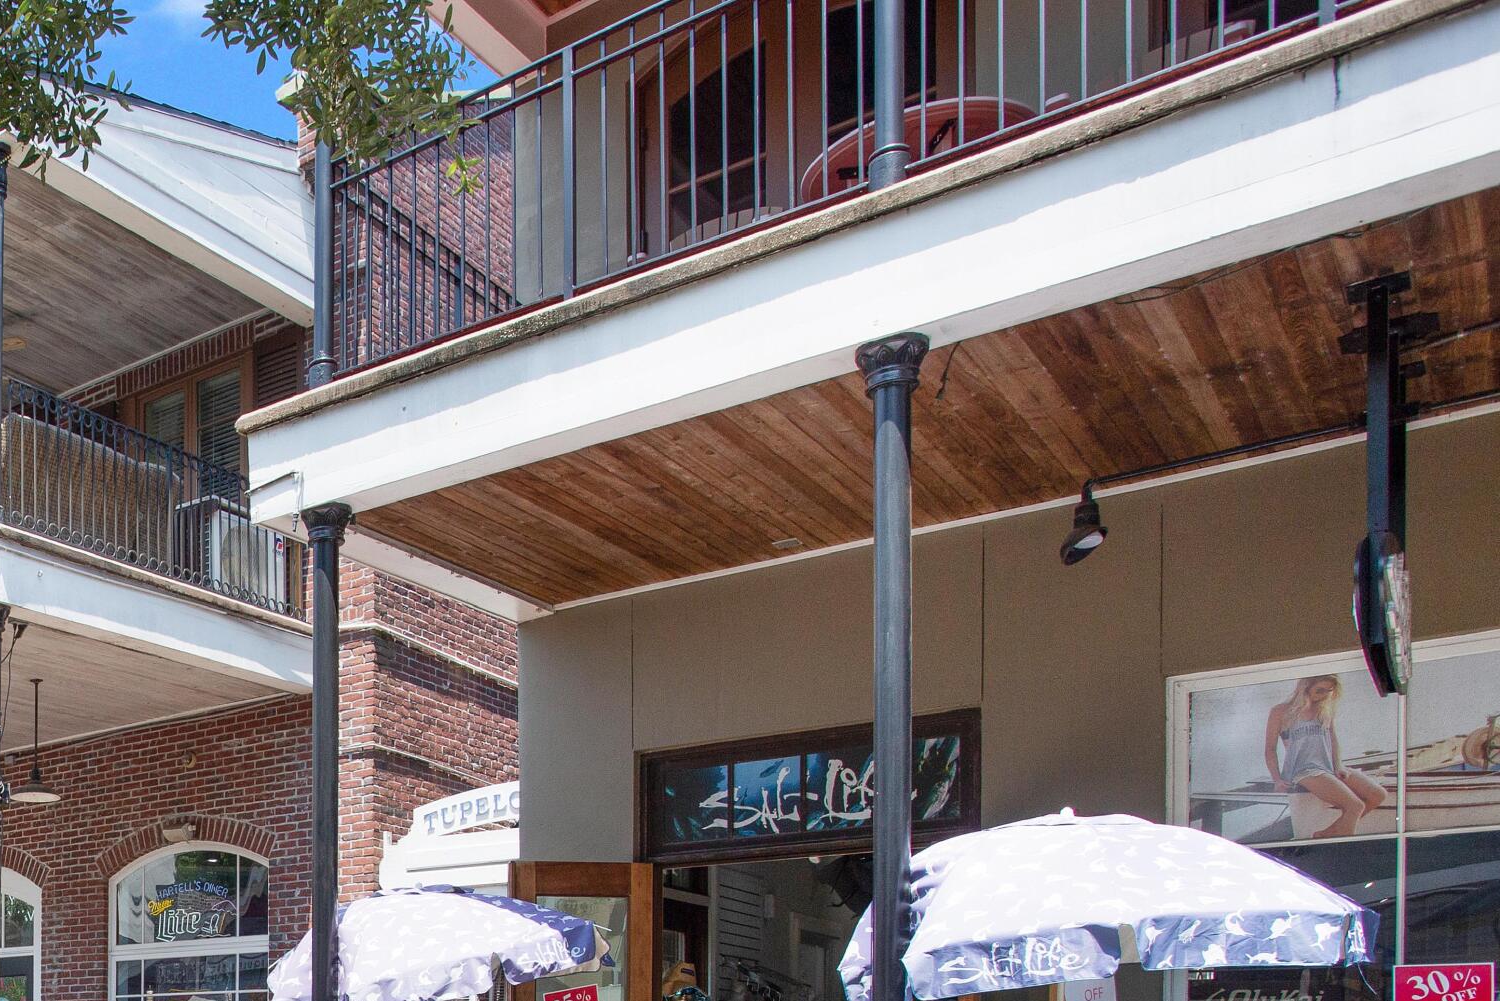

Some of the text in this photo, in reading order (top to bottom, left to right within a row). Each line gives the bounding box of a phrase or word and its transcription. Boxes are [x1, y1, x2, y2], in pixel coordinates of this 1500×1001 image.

[156, 881, 228, 900] HARTELL'S DINER
[156, 907, 201, 942] Lite
[1084, 987, 1104, 1001] OFF
[1407, 968, 1481, 1001] 30%
